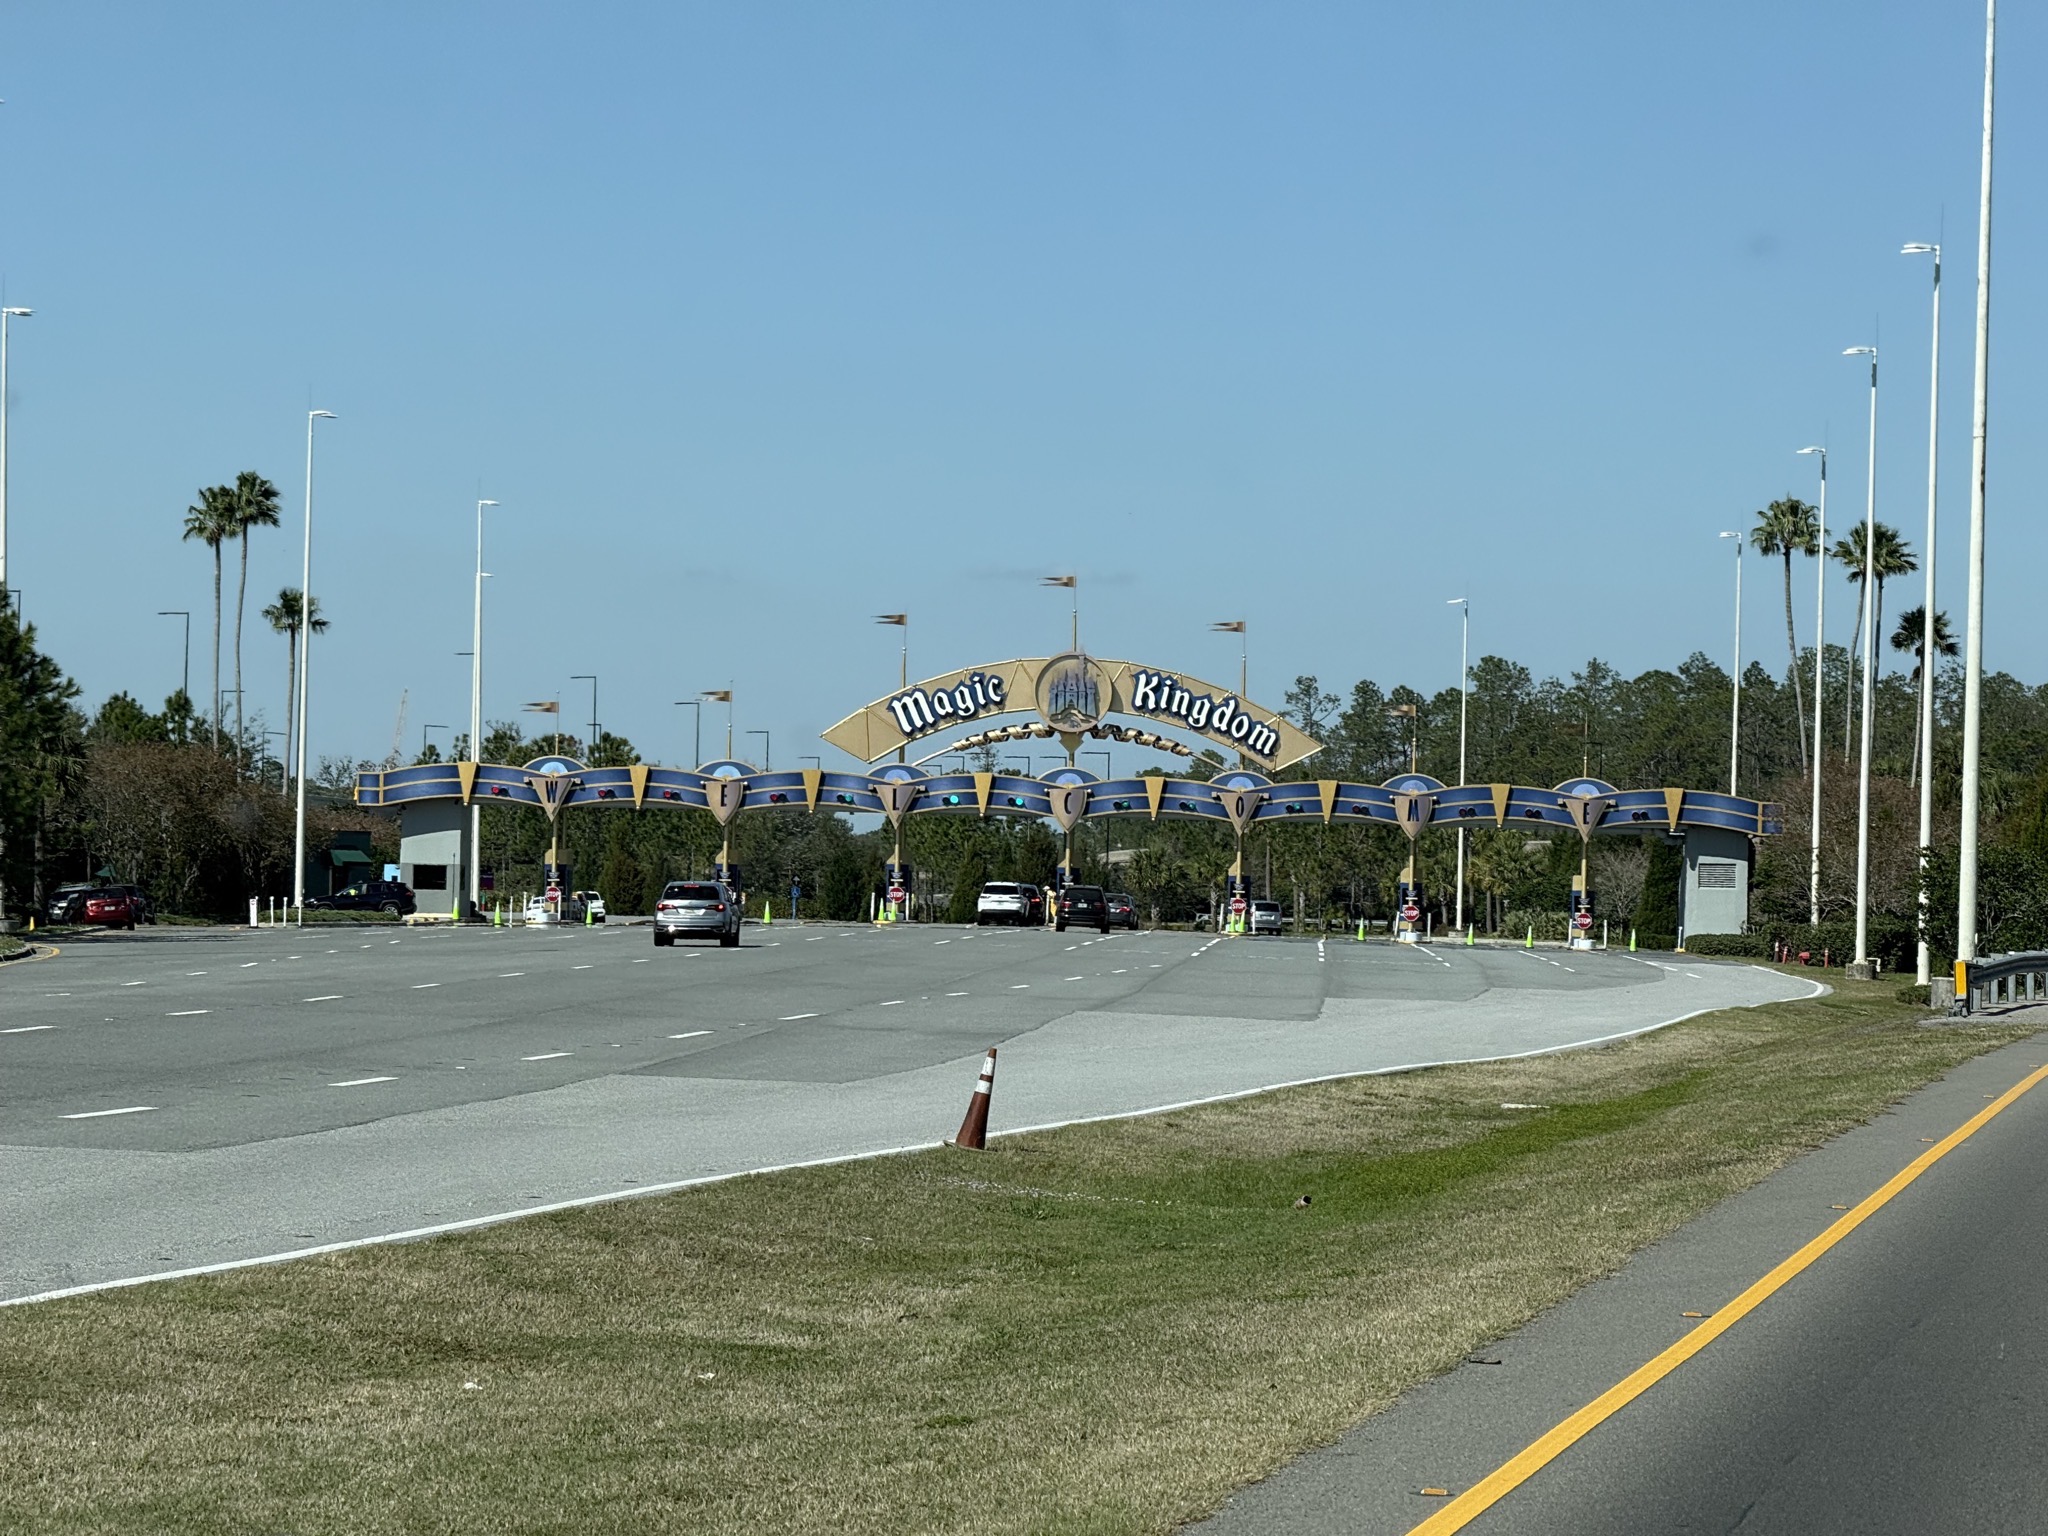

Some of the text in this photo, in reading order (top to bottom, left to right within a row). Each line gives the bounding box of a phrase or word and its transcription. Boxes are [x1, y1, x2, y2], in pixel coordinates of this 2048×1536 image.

[889, 672, 1277, 755] Magic Kingdom
[546, 890, 560, 898] STOP
[1231, 902, 1246, 910] STOP
[1404, 910, 1419, 918] STOP
[1577, 917, 1592, 925] STOP
